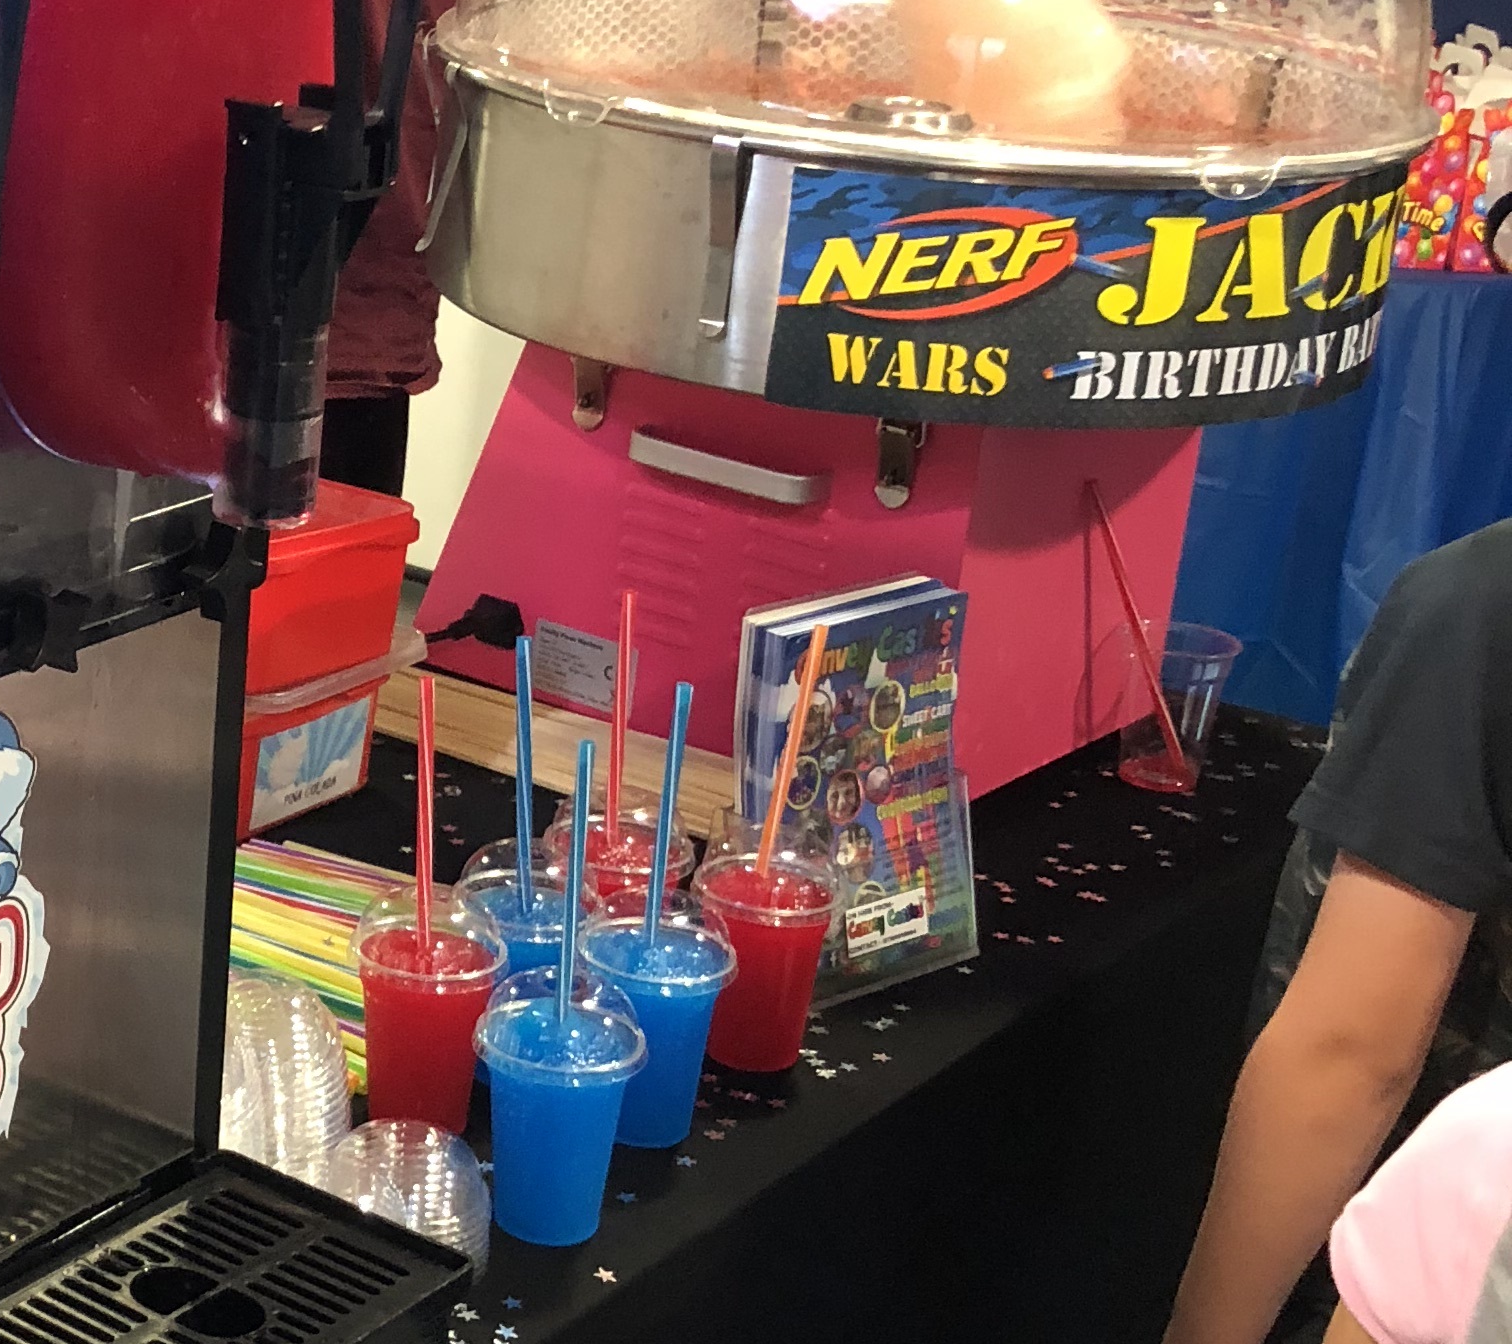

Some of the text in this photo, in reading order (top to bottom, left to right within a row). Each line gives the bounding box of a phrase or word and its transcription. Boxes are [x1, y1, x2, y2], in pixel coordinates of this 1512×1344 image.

[1402, 200, 1445, 232] Time
[799, 216, 1077, 305] NERF
[827, 333, 1011, 397] WARS
[1070, 330, 1336, 402] BIRTHDAY
